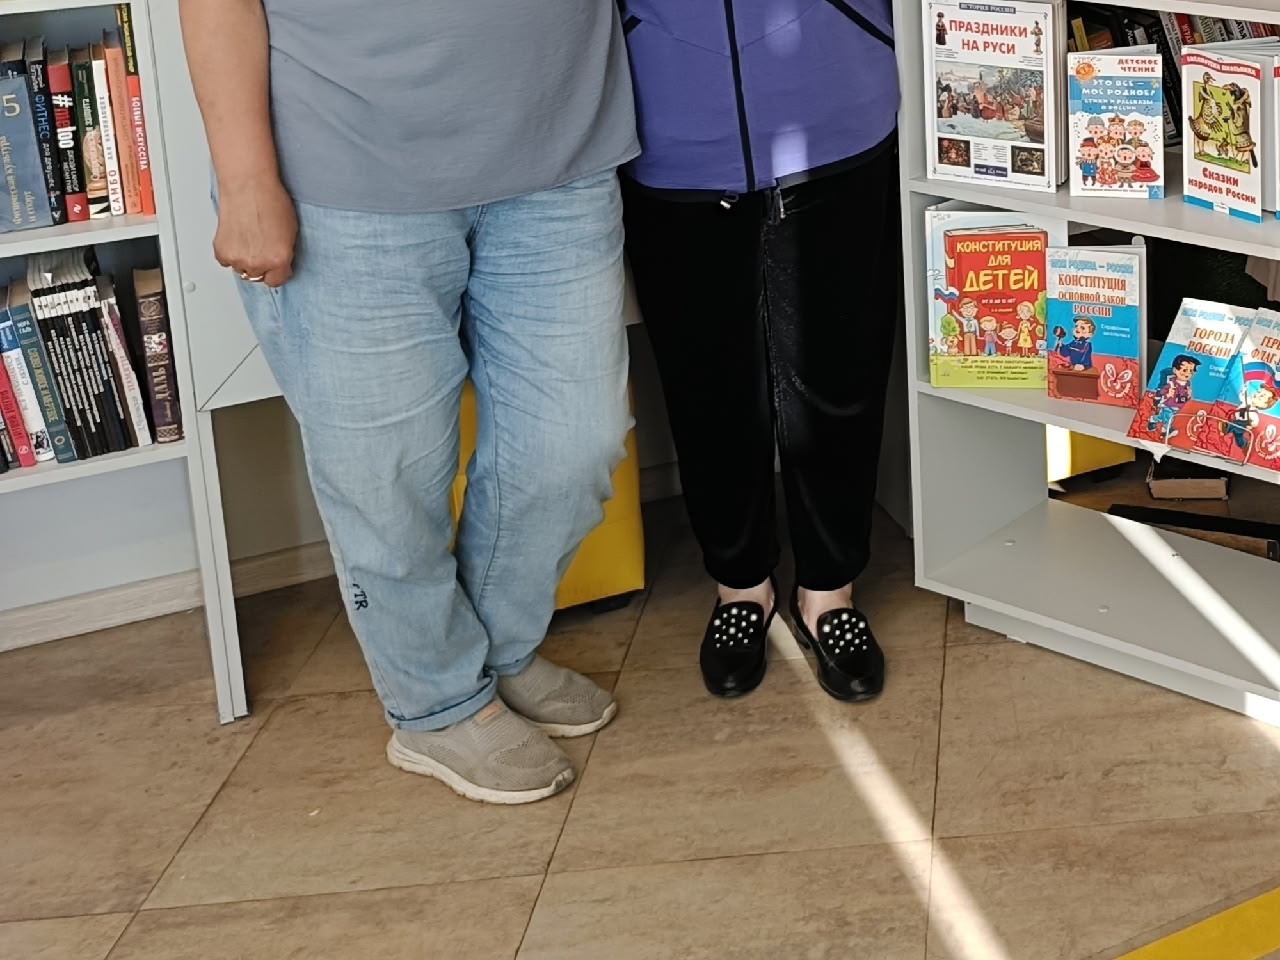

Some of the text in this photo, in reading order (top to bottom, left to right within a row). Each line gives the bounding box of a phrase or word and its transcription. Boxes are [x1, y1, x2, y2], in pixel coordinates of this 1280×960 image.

[948, 19, 1028, 39] ПРАЗДНИКИ
[960, 38, 1017, 56] НА РУСИ
[1117, 57, 1159, 67] ДЕТСКОЕ
[1120, 65, 1156, 74] ЧТЕНИЕ
[1221, 62, 1257, 77] ШКОЛЬНИКА
[1092, 78, 1112, 87] ЭТО
[2, 94, 21, 117] 5
[34, 94, 51, 140] ФИТНЕС
[52, 93, 75, 149] #metoo
[131, 96, 149, 171] БОЕВЫЕ ИСКУССТВА
[42, 142, 52, 157] для
[1201, 167, 1240, 189] Сказки
[108, 168, 123, 213] САМБО
[1187, 176, 1257, 205] народов России
[955, 239, 1042, 254] КОНСТИТУЦИЯ
[987, 254, 1012, 267] ДЛЯ
[962, 264, 1040, 293] ДЕТЕЙ
[1057, 273, 1127, 291] КОНСТИТУЦИЯ
[1057, 291, 1127, 305] ОСНОВНОЙ ЗАКОН
[1073, 304, 1112, 317] РОССИИ
[1192, 327, 1236, 345] ГОРОДА
[1186, 341, 1233, 359] РОССИИ
[1250, 347, 1277, 365] ФЛАГ
